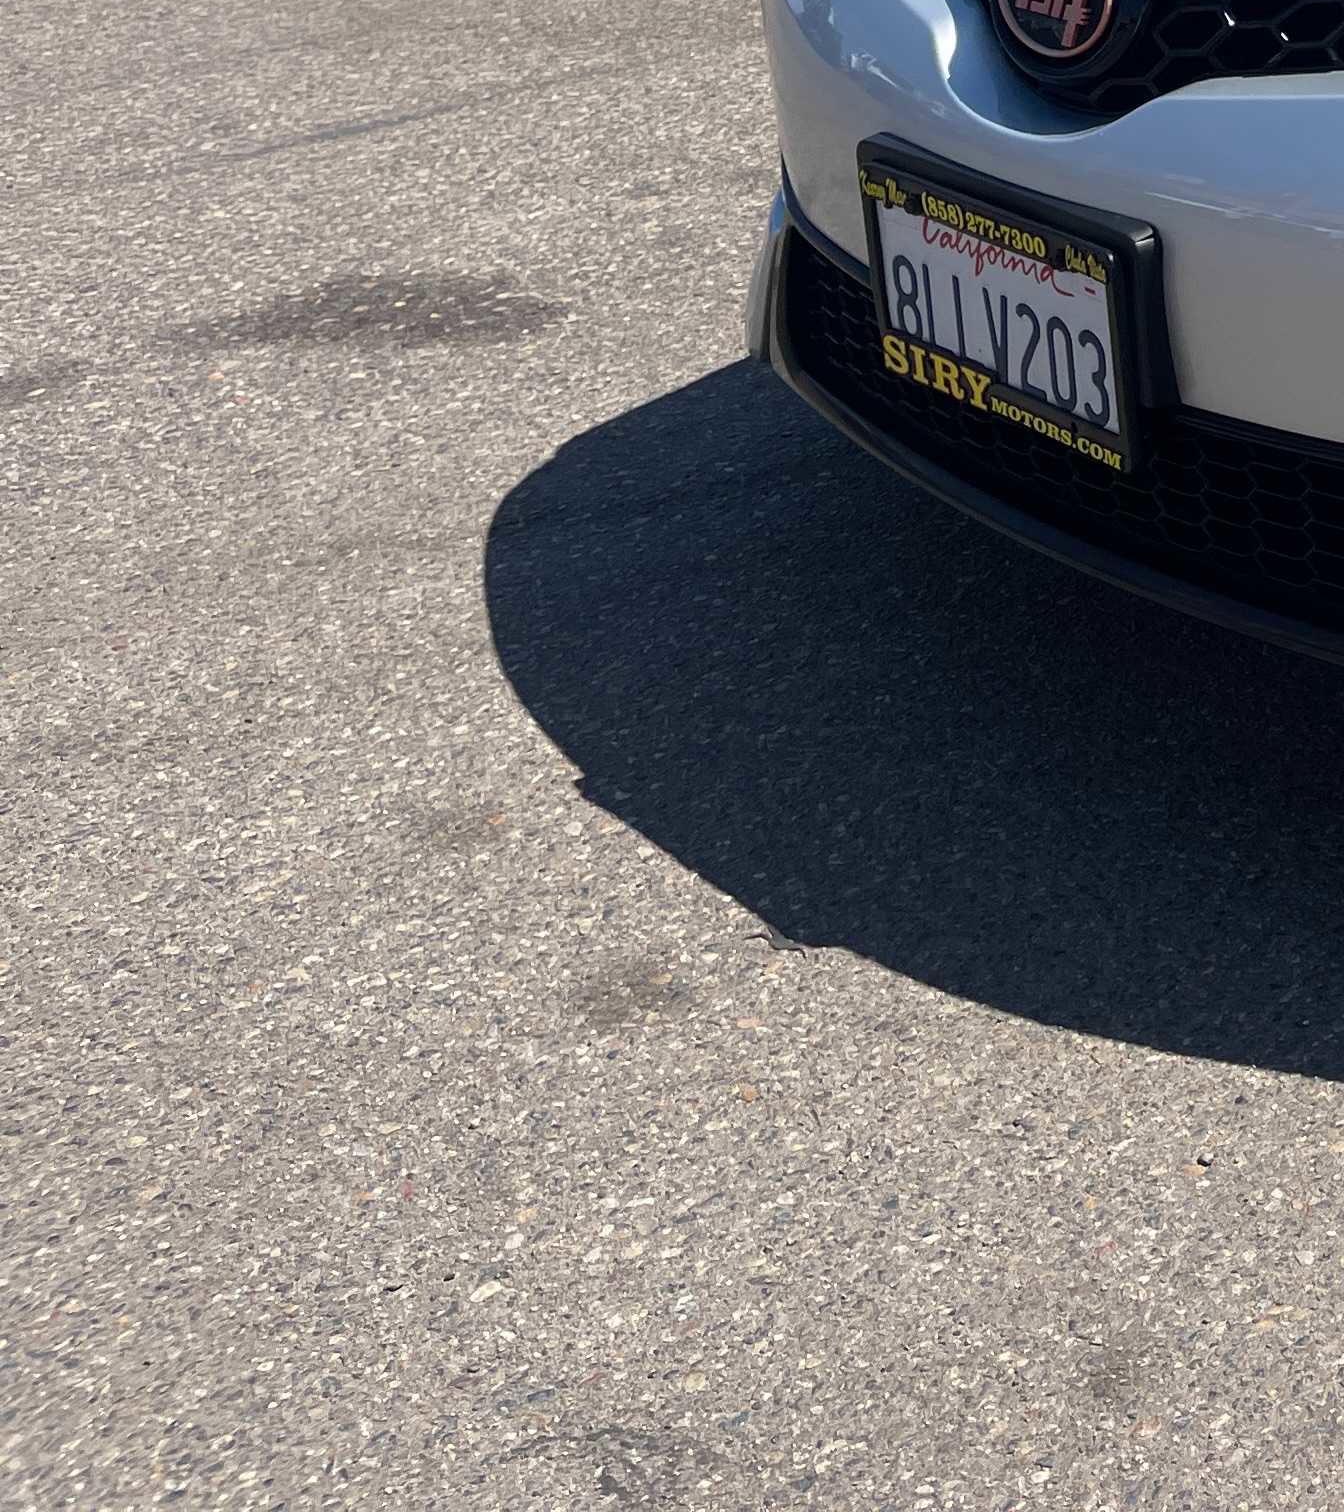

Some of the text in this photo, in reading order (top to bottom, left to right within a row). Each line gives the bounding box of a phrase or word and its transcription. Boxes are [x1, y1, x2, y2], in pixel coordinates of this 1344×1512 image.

[921, 191, 1046, 258] (858) 277-7300
[922, 216, 1074, 298] California
[882, 334, 991, 410] SIRY
[990, 397, 1122, 470] MOTORS.COM
